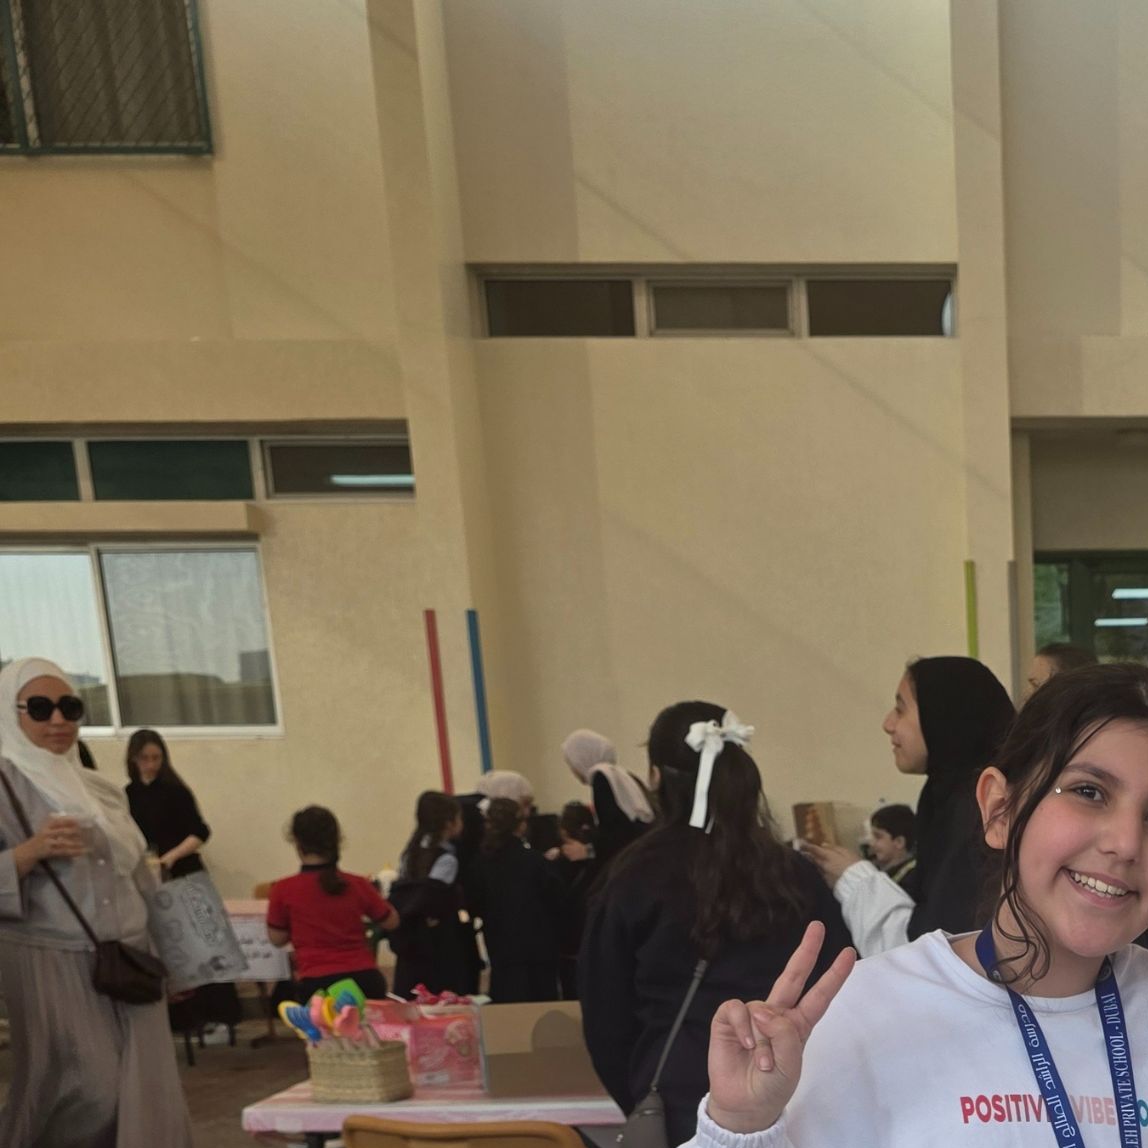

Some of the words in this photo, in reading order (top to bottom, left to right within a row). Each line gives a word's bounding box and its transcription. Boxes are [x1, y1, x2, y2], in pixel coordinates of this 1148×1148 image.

[1101, 993, 1121, 1025] DUBAI
[1017, 1003, 1040, 1048] مدرسة
[1032, 1053, 1056, 1090] الراشد
[1046, 1095, 1075, 1138] الصالح
[1109, 1031, 1128, 1078] SCHOOL
[960, 1094, 1051, 1124] POSITIV
[1070, 1095, 1117, 1126] VIBE
[1117, 1079, 1138, 1128] PRIVATE
